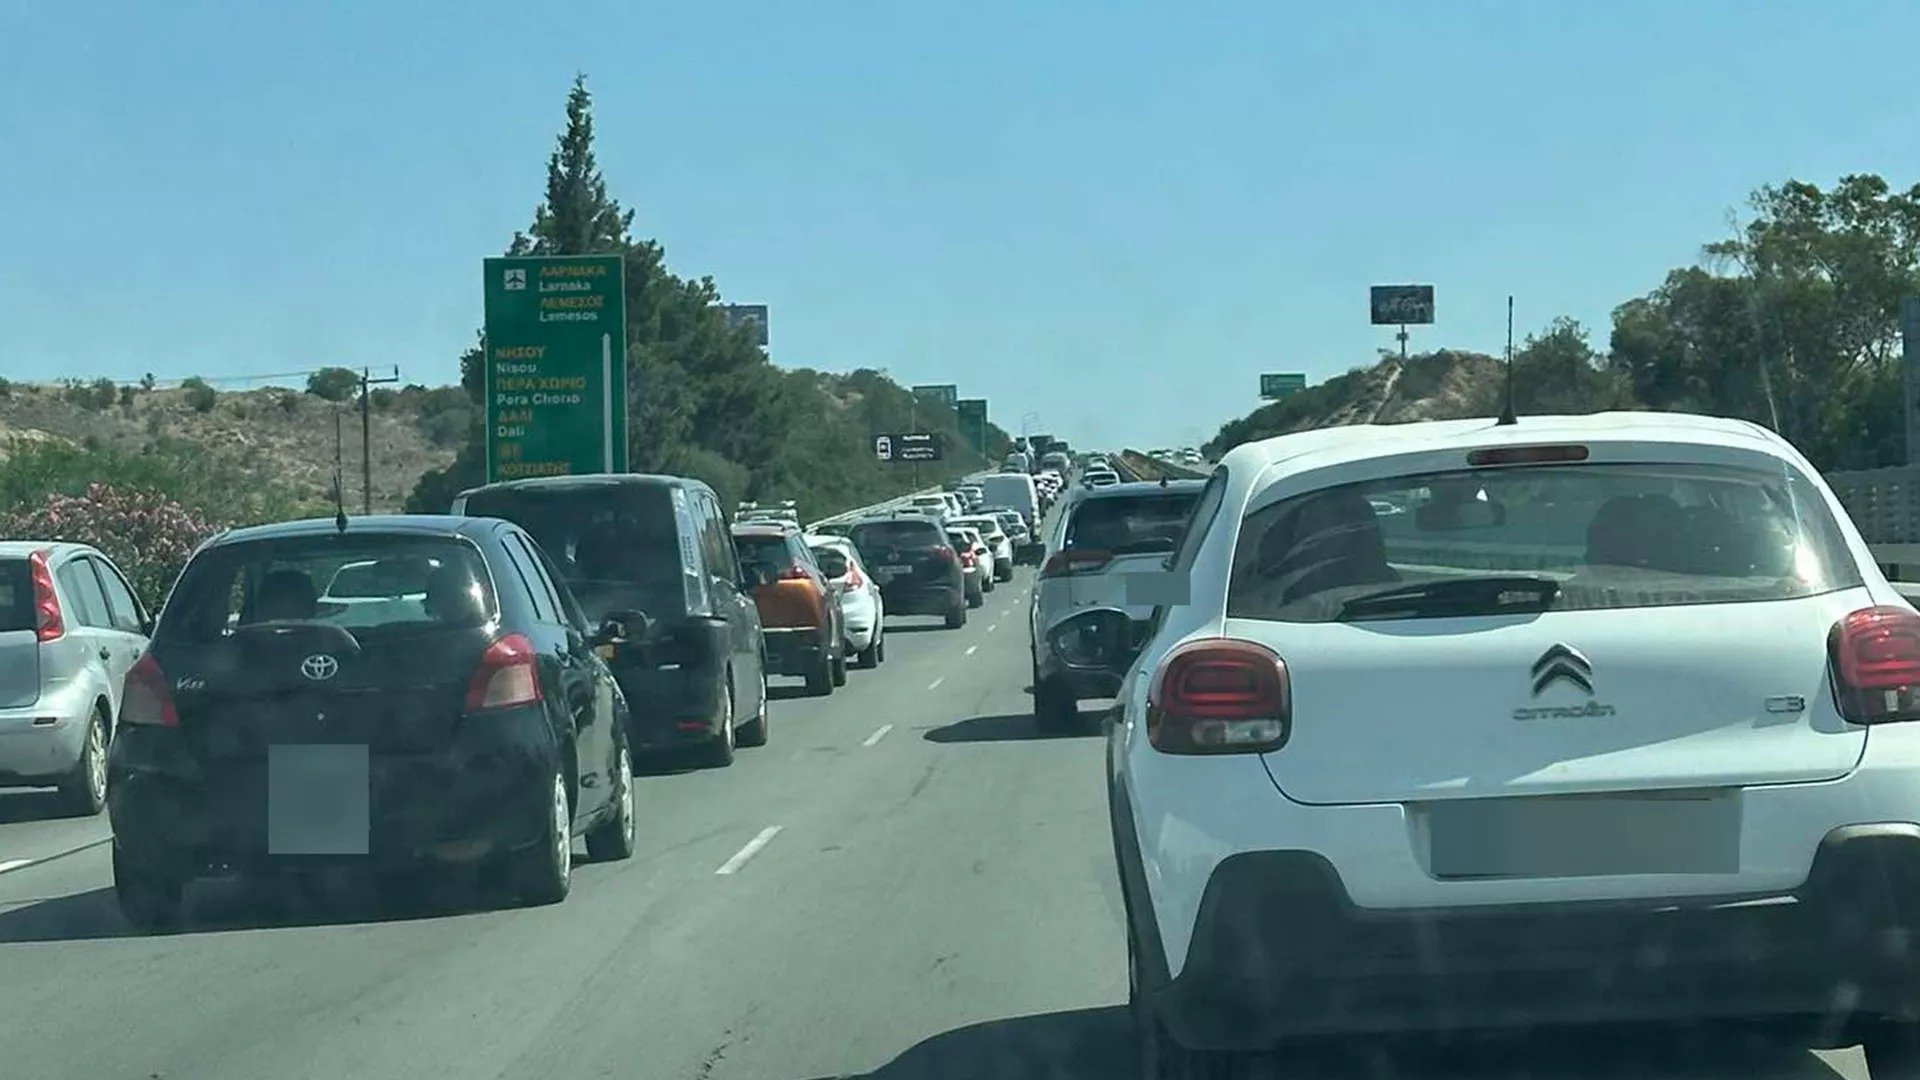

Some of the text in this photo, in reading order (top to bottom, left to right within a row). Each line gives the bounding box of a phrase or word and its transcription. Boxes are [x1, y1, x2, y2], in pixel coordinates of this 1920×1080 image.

[540, 311, 598, 322] Lemesos
[496, 362, 537, 373] Nisou
[496, 394, 528, 405] Pera
[497, 426, 525, 438] Dali
